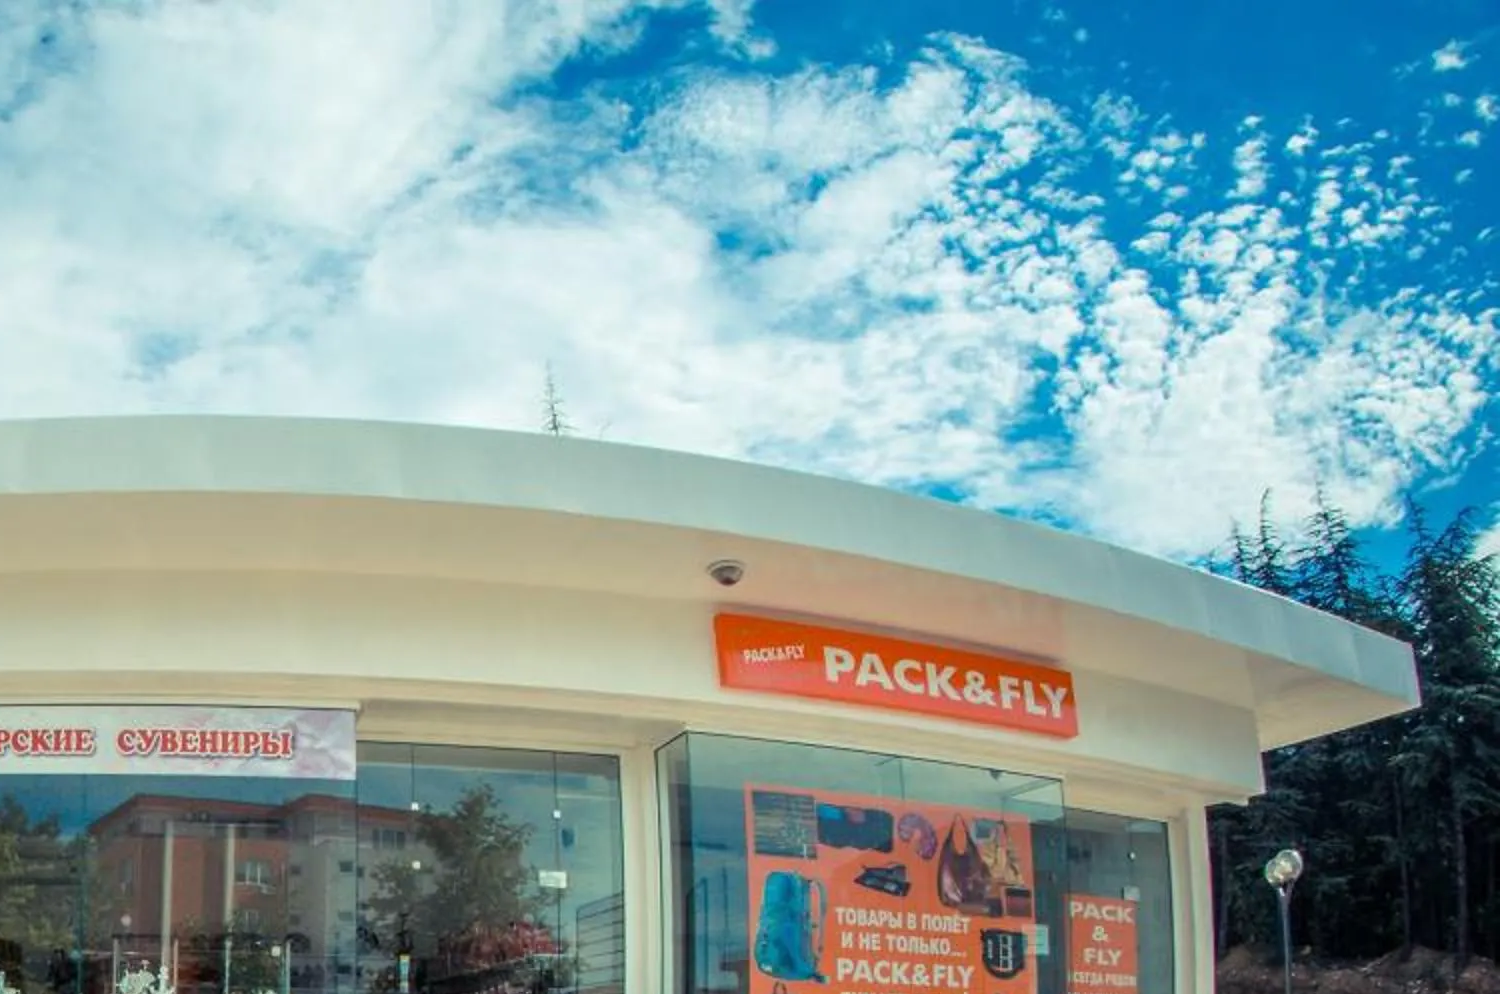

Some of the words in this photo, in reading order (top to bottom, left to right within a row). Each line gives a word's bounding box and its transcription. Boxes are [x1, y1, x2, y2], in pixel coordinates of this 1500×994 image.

[742, 643, 805, 665] PACK&FLY
[823, 646, 1067, 719] PACK&FLY
[116, 728, 293, 758] СУВЕНИРЫ
[835, 906, 903, 929] ТОВАРЫ
[907, 912, 917, 930] В
[1070, 901, 1135, 924] PACK
[841, 931, 853, 949] И
[859, 932, 881, 951] НЕ
[1092, 925, 1109, 942] &
[1083, 947, 1123, 966] FLY
[836, 957, 975, 989] PACK&FLY
